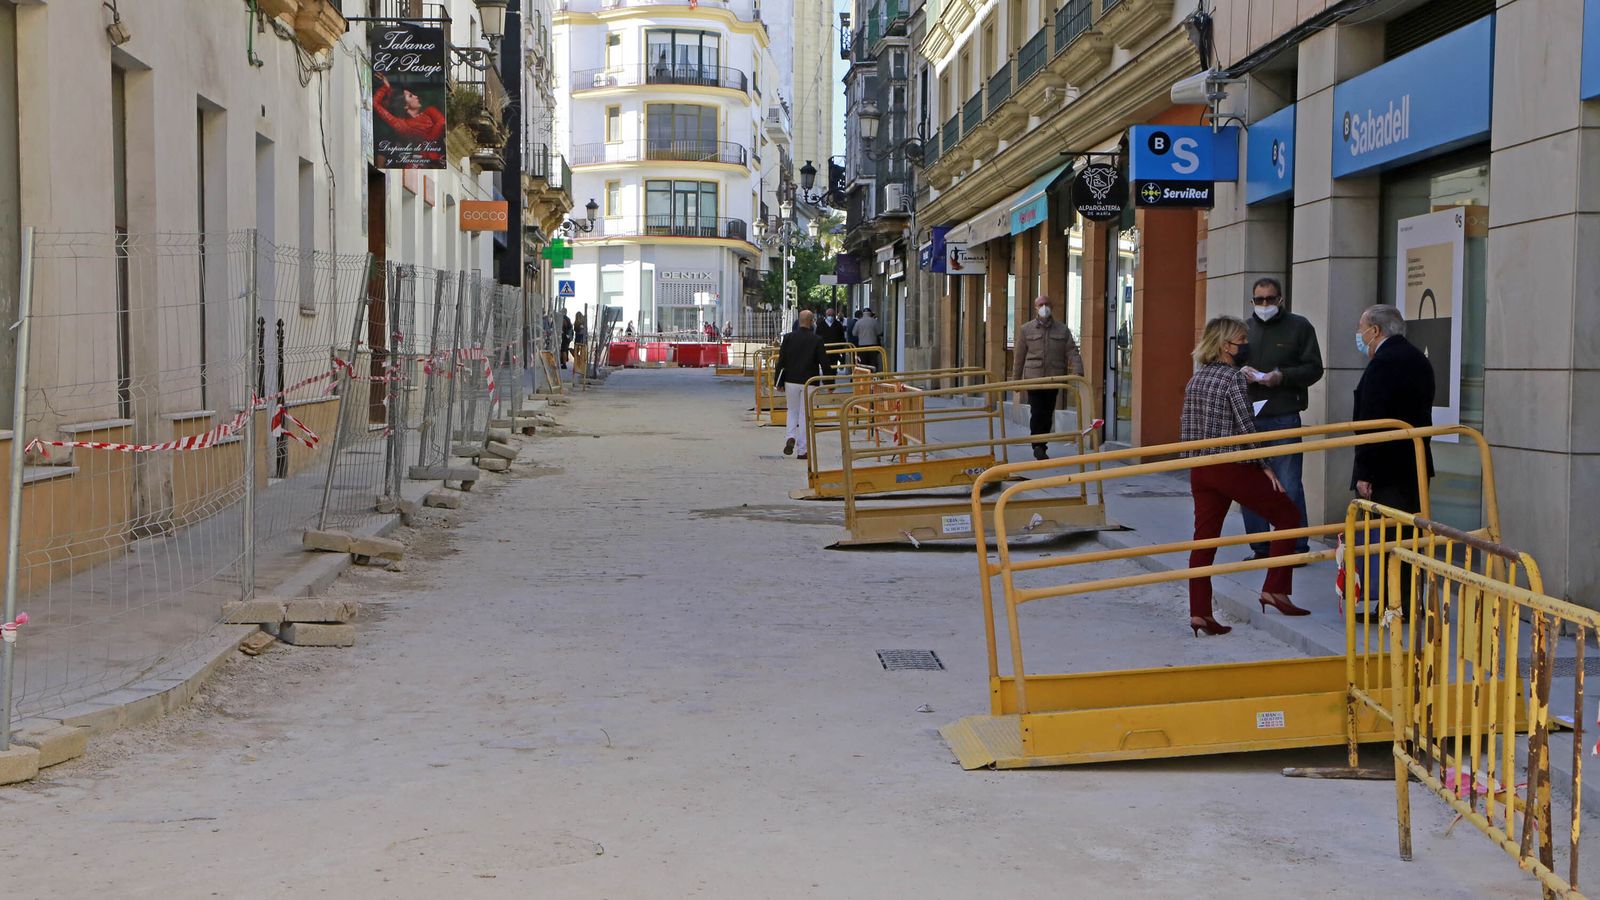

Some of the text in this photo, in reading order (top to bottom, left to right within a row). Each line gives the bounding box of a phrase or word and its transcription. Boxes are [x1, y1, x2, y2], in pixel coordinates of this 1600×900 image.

[379, 30, 436, 50] Tabanco
[373, 52, 442, 78] El Pasaje
[1351, 94, 1410, 156] Sabadell
[378, 140, 413, 155] Despacho
[422, 140, 441, 152] Vinos
[396, 151, 431, 164] Flamenco
[1163, 187, 1209, 199] ServiRed
[463, 211, 507, 221] GOCCO
[660, 271, 713, 280] DENTIX
